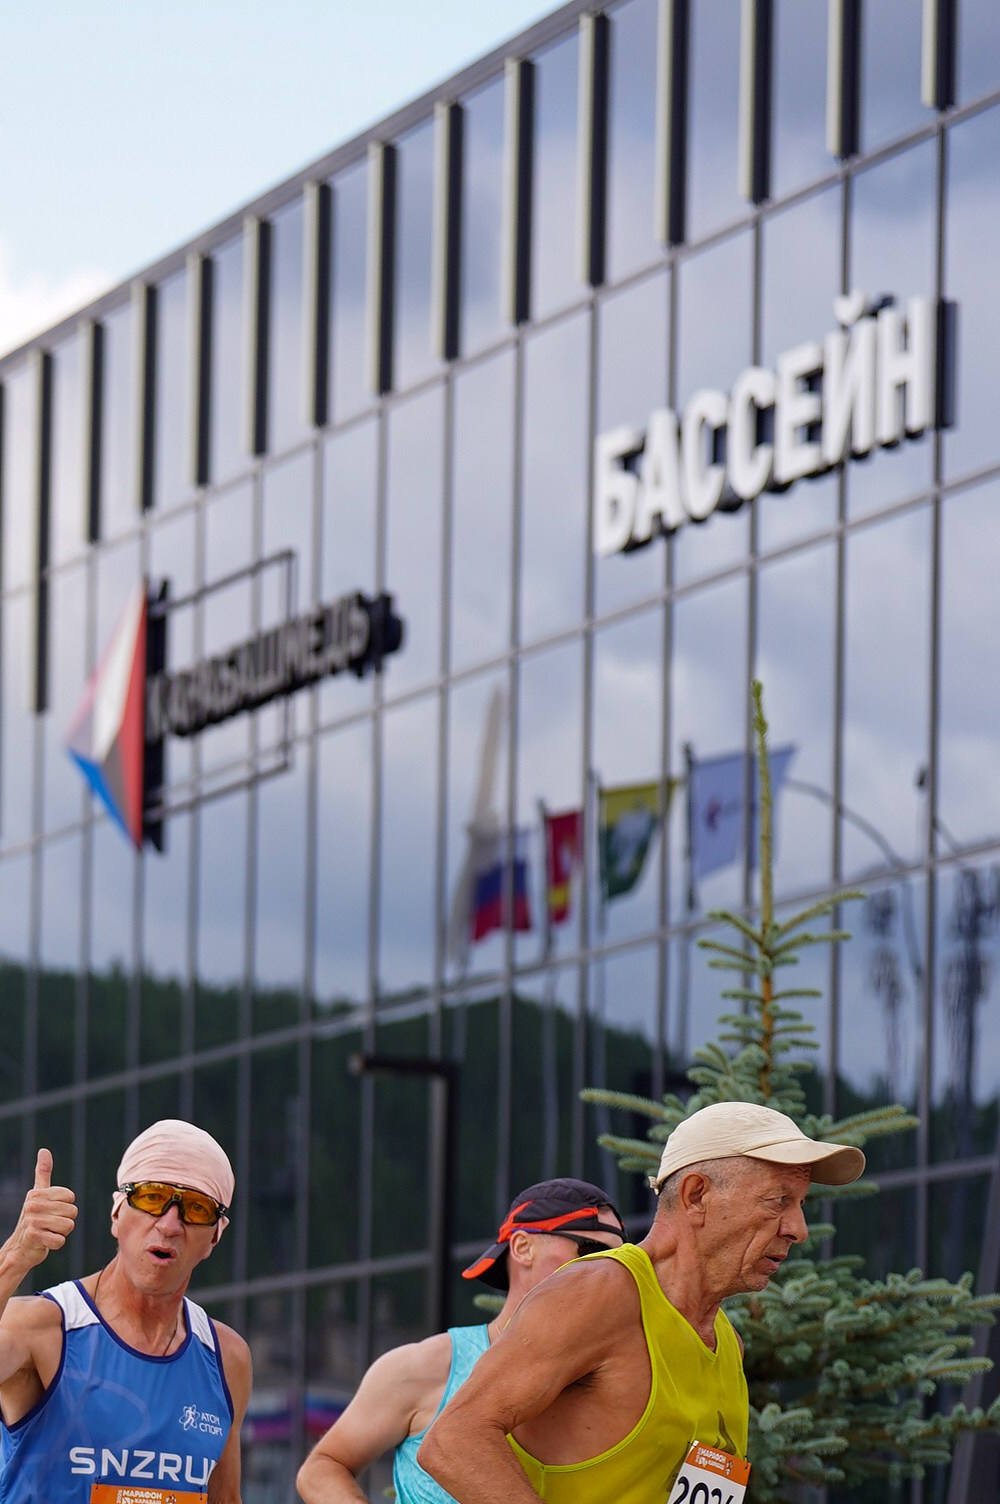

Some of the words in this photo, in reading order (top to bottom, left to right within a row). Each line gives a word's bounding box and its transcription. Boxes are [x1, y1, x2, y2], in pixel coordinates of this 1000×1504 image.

[593, 289, 935, 557] БАССЕЙН
[201, 1412, 221, 1425] АТОМ
[199, 1423, 223, 1436] СПОРТ
[123, 1489, 162, 1500] МАРАФОН
